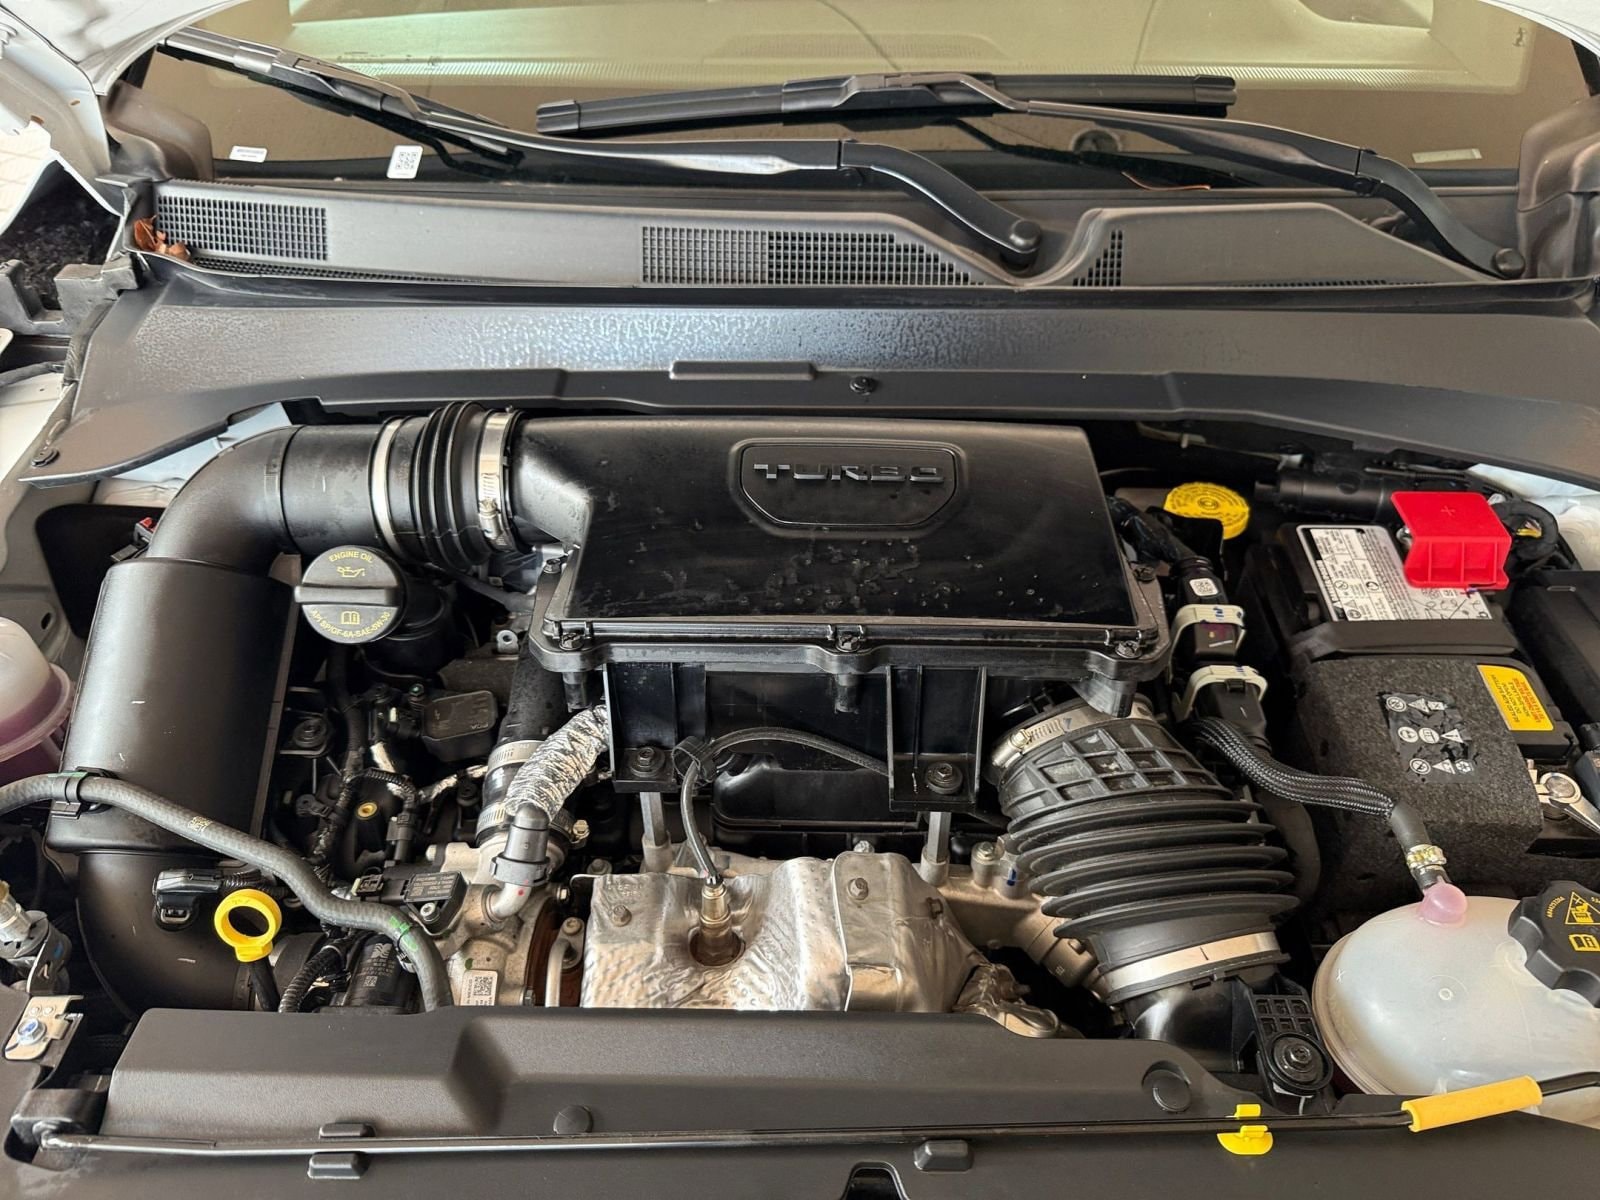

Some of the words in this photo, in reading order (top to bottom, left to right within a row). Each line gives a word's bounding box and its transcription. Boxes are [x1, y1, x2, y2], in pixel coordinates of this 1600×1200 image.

[753, 463, 945, 483] TURBO
[328, 551, 360, 562] ENGINE
[360, 551, 374, 563] OIL
